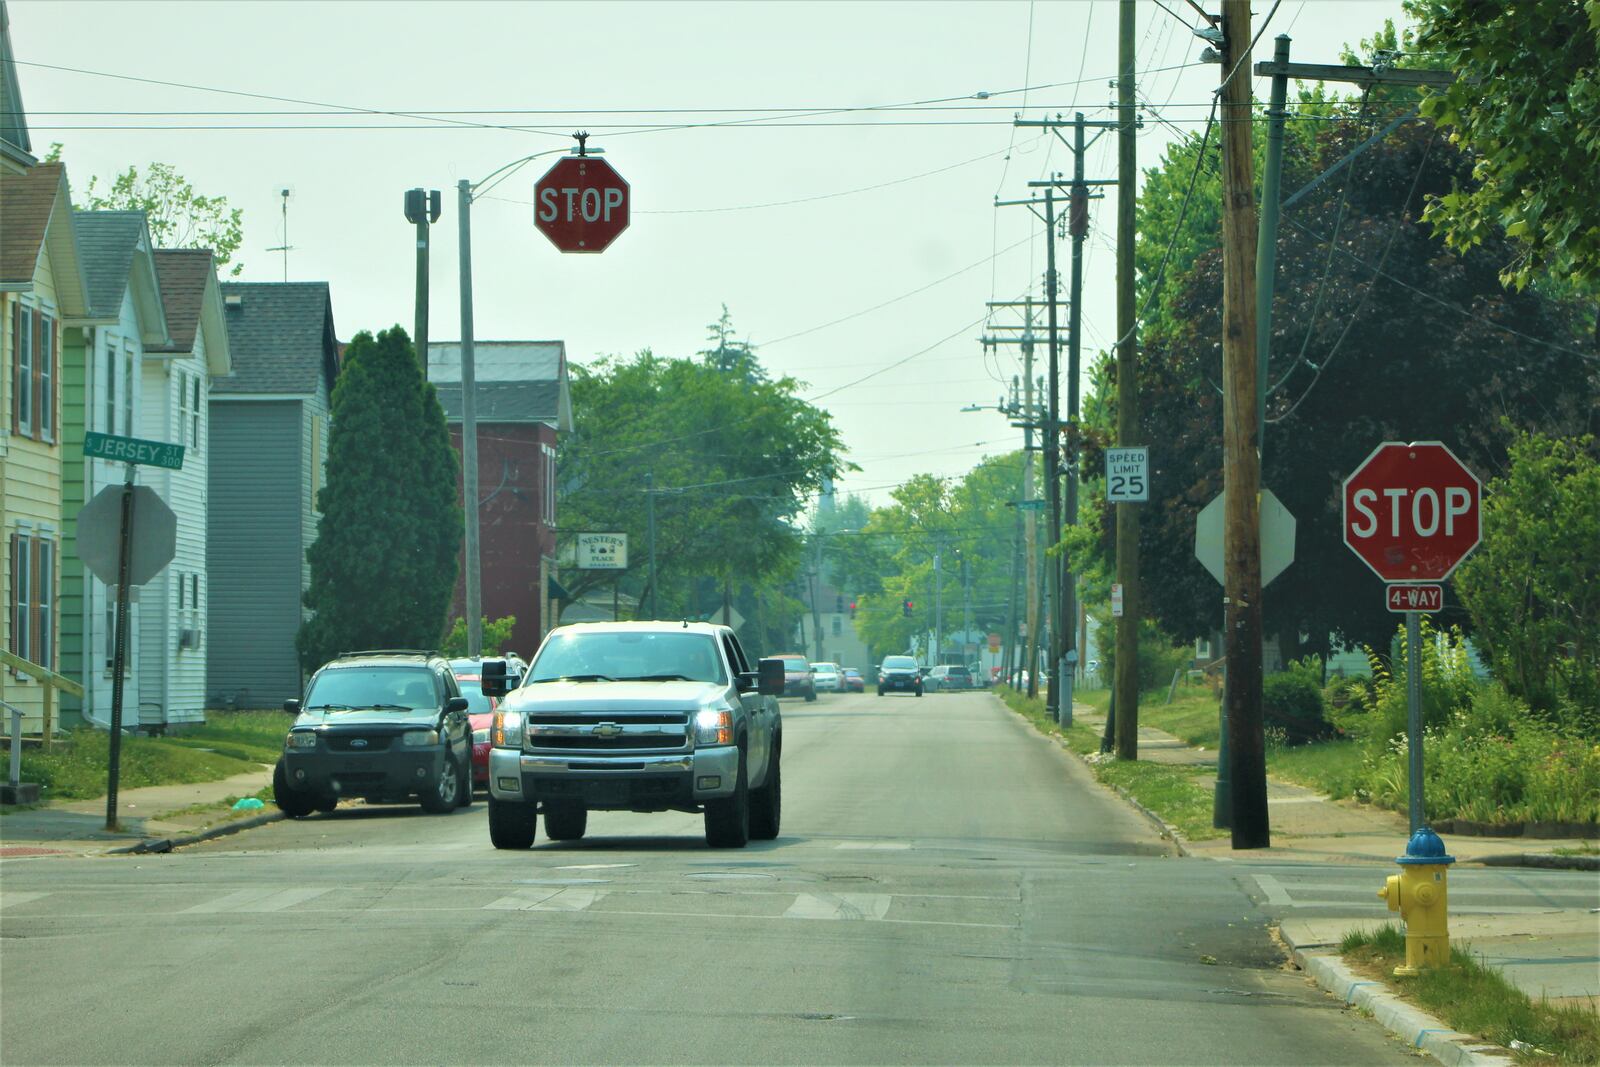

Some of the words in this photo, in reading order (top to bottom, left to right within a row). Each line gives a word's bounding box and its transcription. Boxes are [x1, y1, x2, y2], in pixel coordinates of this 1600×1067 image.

[539, 188, 624, 222] STOP
[86, 438, 92, 448] S
[94, 439, 160, 461] JERSEY
[166, 446, 178, 456] ST
[1109, 454, 1145, 463] SPEED
[161, 456, 181, 467] 300
[1113, 465, 1141, 474] LIMIT
[1111, 476, 1144, 496] 25
[1351, 487, 1471, 538] STOP
[1391, 590, 1438, 607] 4-WAY
